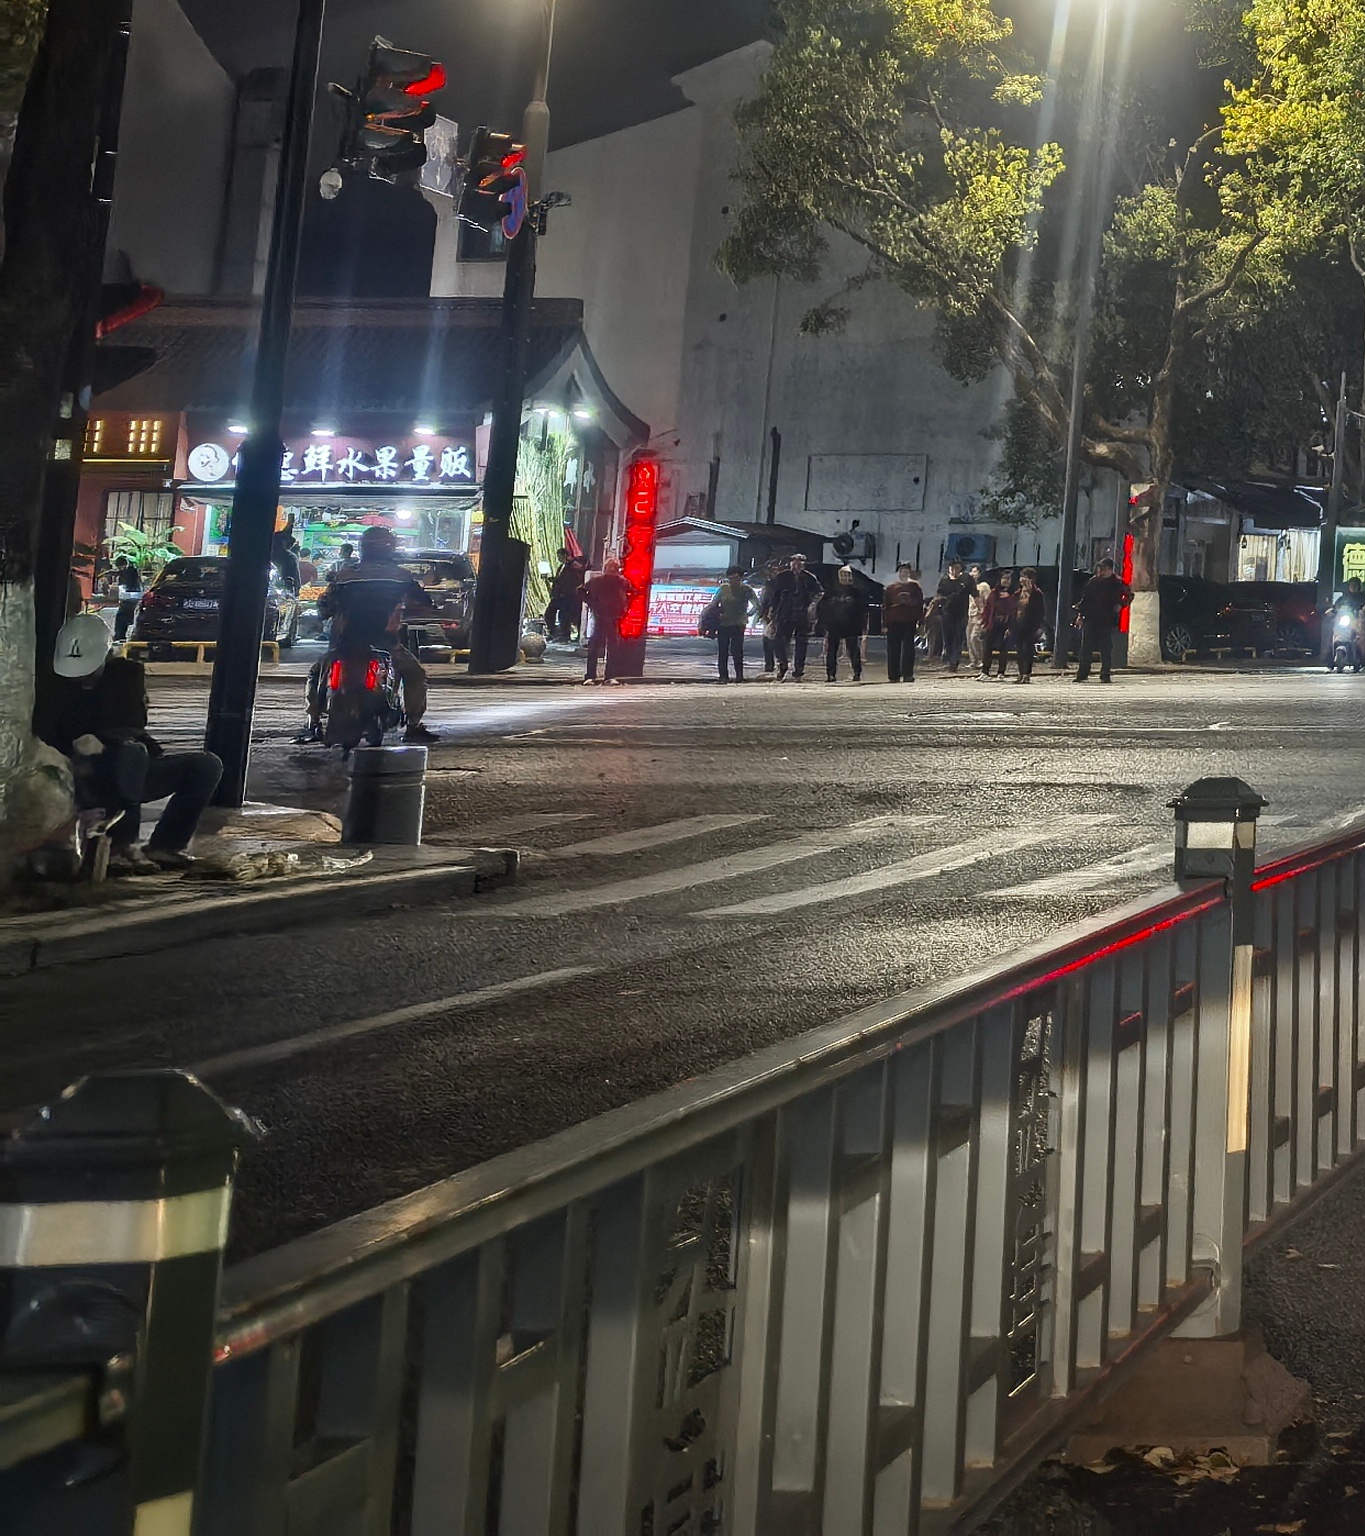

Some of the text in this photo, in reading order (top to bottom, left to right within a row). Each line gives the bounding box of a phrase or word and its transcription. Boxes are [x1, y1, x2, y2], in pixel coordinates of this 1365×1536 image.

[232, 443, 472, 482] 鲜水果量贩
